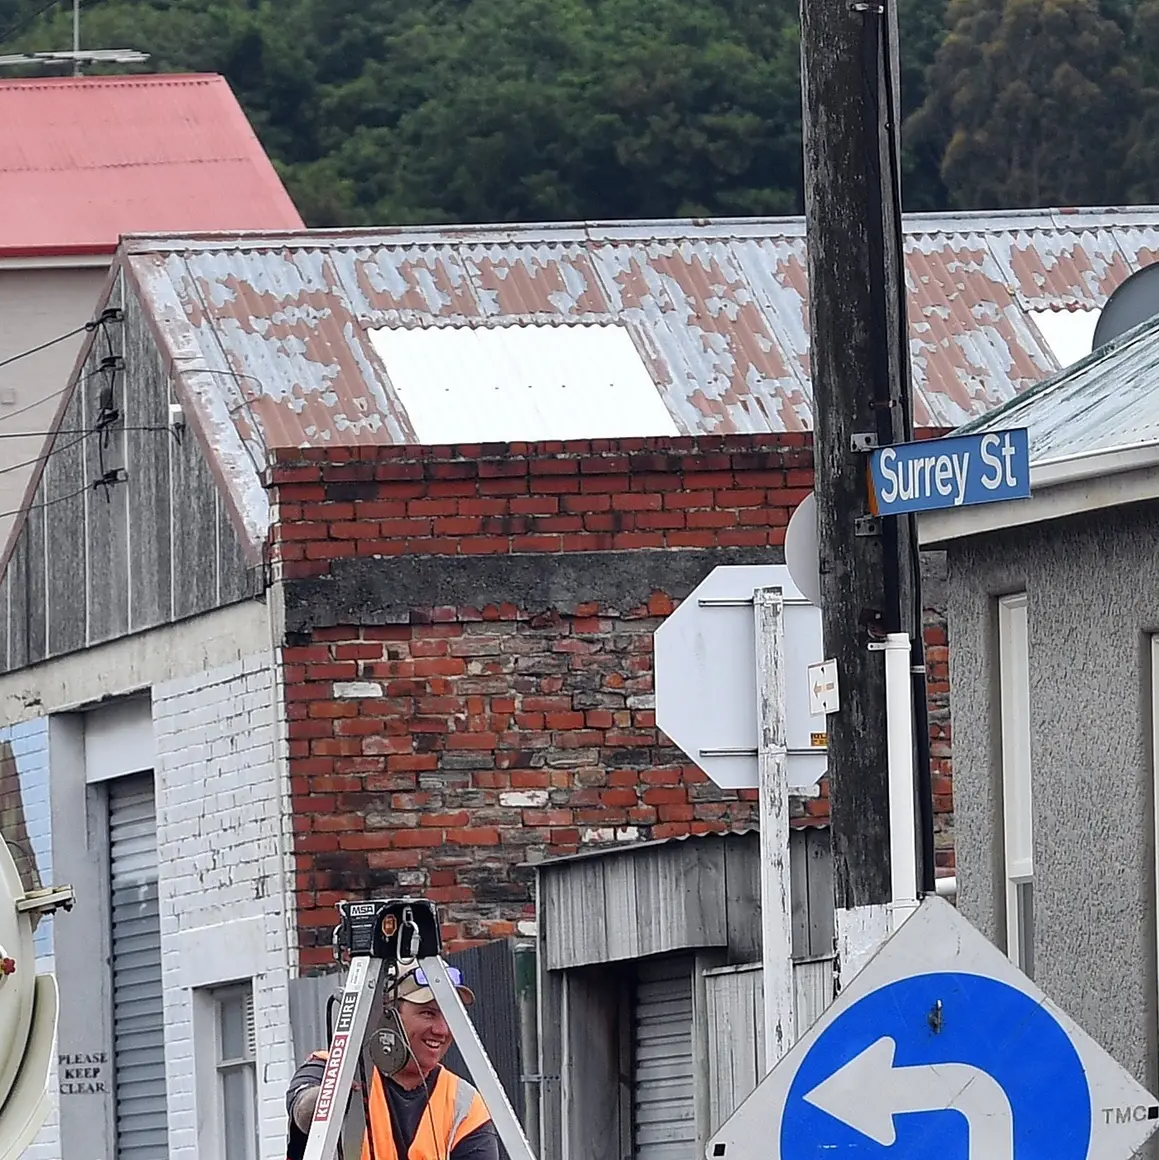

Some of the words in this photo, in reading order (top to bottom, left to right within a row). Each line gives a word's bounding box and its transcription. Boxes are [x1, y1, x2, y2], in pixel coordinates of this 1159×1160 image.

[879, 447, 970, 506] Surrey
[980, 431, 1017, 490] St
[351, 905, 374, 915] MSA
[58, 1053, 108, 1065] PLEASE
[316, 1037, 345, 1118] KENNARDS
[339, 995, 357, 1029] HIRE
[65, 1067, 100, 1079] KEEP
[60, 1082, 110, 1095] CLEAR
[1101, 1105, 1147, 1125] TMC
